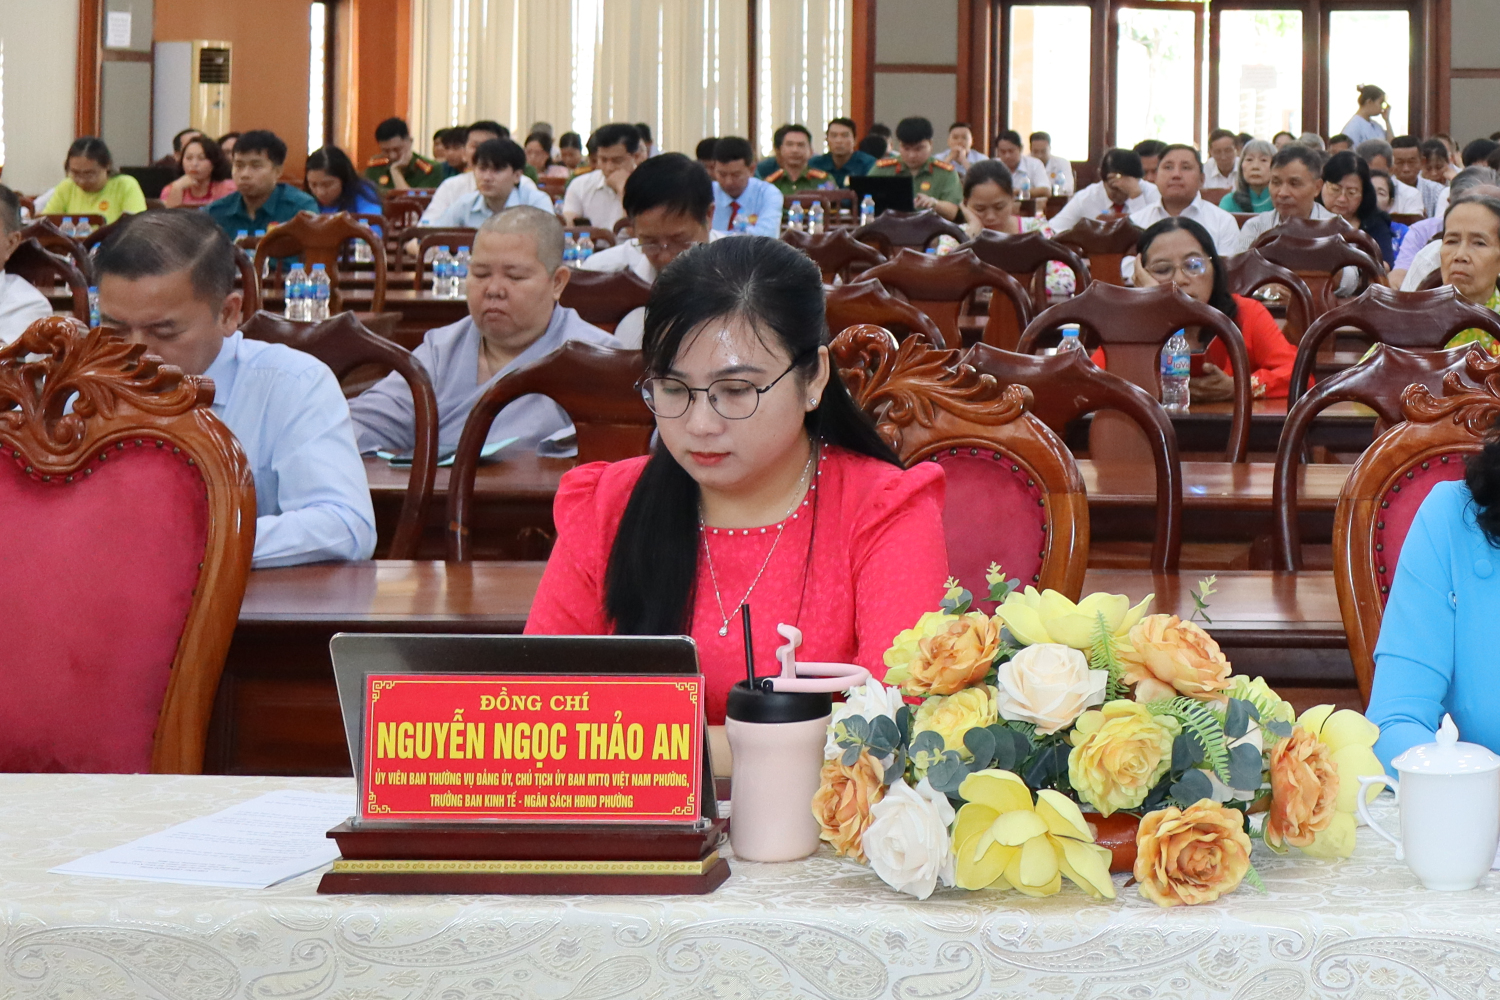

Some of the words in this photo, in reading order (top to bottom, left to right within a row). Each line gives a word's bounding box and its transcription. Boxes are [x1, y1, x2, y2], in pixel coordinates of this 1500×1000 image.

[480, 686, 543, 711] ĐỒNG
[550, 691, 590, 711] CHÍ
[376, 708, 485, 761] NGUYỄN
[493, 721, 567, 769] NGỌC
[576, 710, 645, 761] THẢO
[651, 723, 691, 761] AN
[375, 768, 386, 785] ỦY
[388, 769, 407, 785] VIÊN
[409, 772, 426, 785] BAN
[429, 769, 461, 785] THƯỜNG
[464, 772, 474, 788] VỤ
[476, 768, 499, 786] ĐẢNG
[501, 769, 513, 787] ỦY,
[516, 769, 532, 786] CHỦ
[535, 773, 553, 788] TỊCH
[555, 769, 566, 786] ỦY
[568, 773, 585, 786] BAN
[588, 773, 609, 787] MTTQ
[612, 771, 629, 789] VIỆT
[632, 773, 651, 787] NAM
[653, 770, 690, 788] PHƯỜNG,
[430, 790, 463, 807] TRƯỞNG
[465, 794, 482, 807] BAN
[484, 794, 505, 807] KINH
[507, 791, 517, 807] TẾ
[524, 793, 548, 808] NGÂN
[550, 792, 572, 808] SÁCH
[574, 795, 597, 808] HĐND
[599, 792, 634, 808] PHƯỜNG
